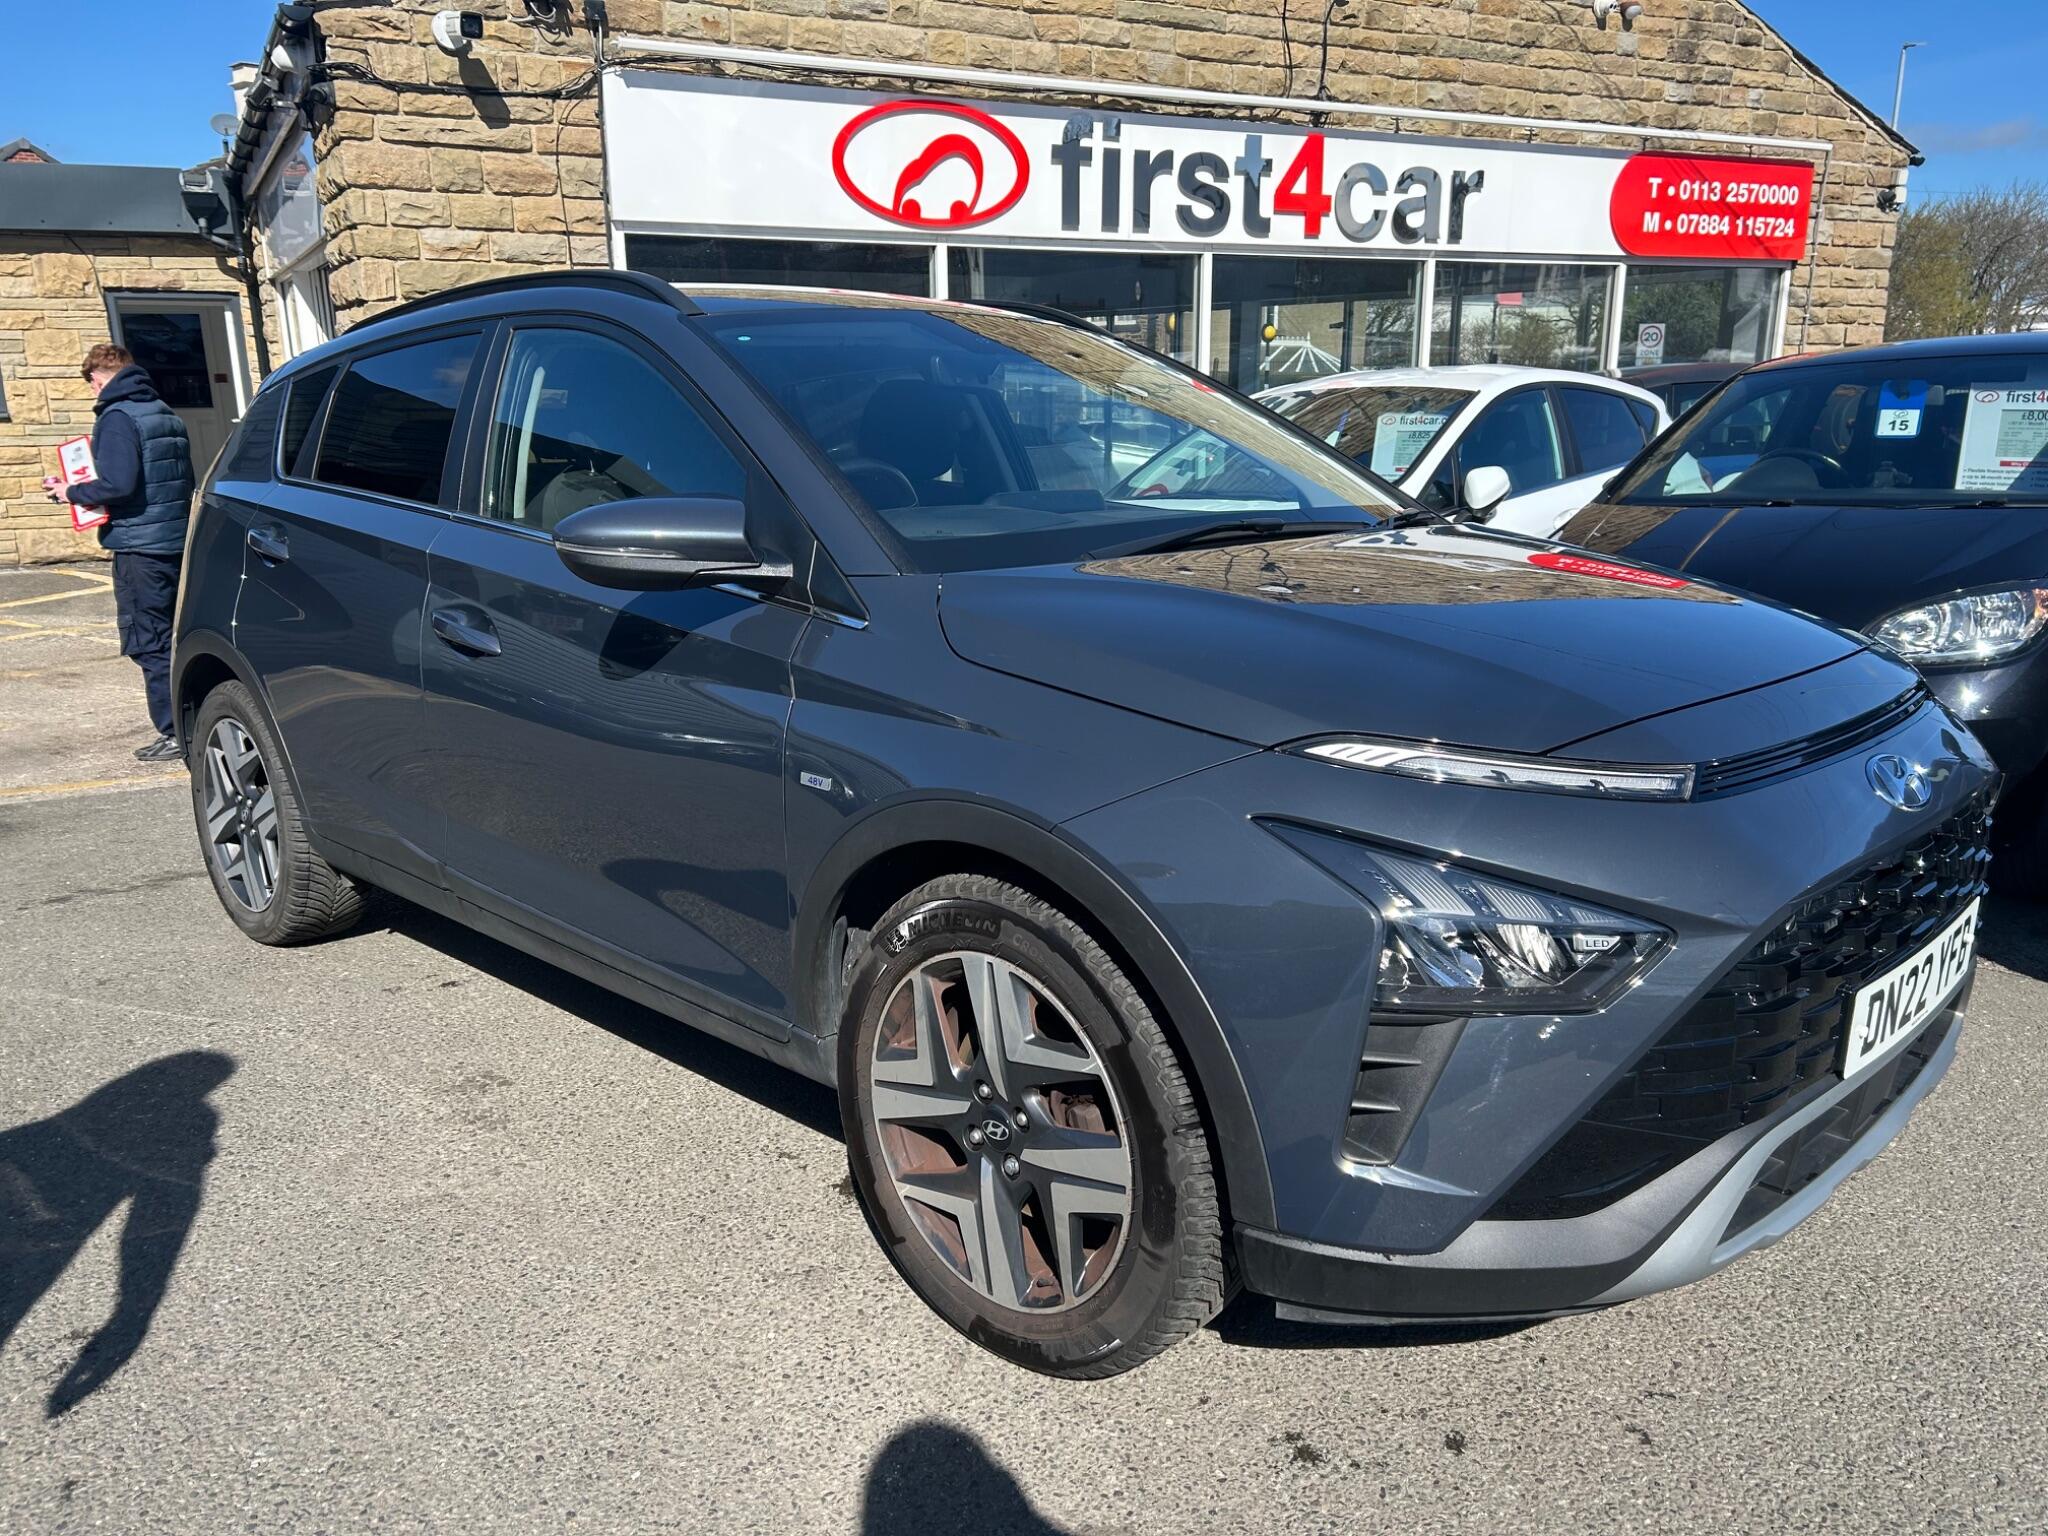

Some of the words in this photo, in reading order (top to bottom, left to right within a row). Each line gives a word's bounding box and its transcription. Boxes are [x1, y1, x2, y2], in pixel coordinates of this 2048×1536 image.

[1051, 113, 1485, 244] first4car
[1648, 177, 1662, 198] T
[1679, 179, 1721, 201] 0113
[1725, 182, 1799, 206] 2570000
[1642, 211, 1660, 233] M
[1676, 213, 1730, 235] 07884
[1735, 216, 1795, 238] 115724
[1643, 332, 1659, 341] 20
[1887, 419, 1909, 431] 15
[808, 776, 824, 787] 48V
[906, 911, 996, 939] MICHELIN
[1585, 940, 1610, 948] LED
[1860, 953, 1934, 1058] DN22
